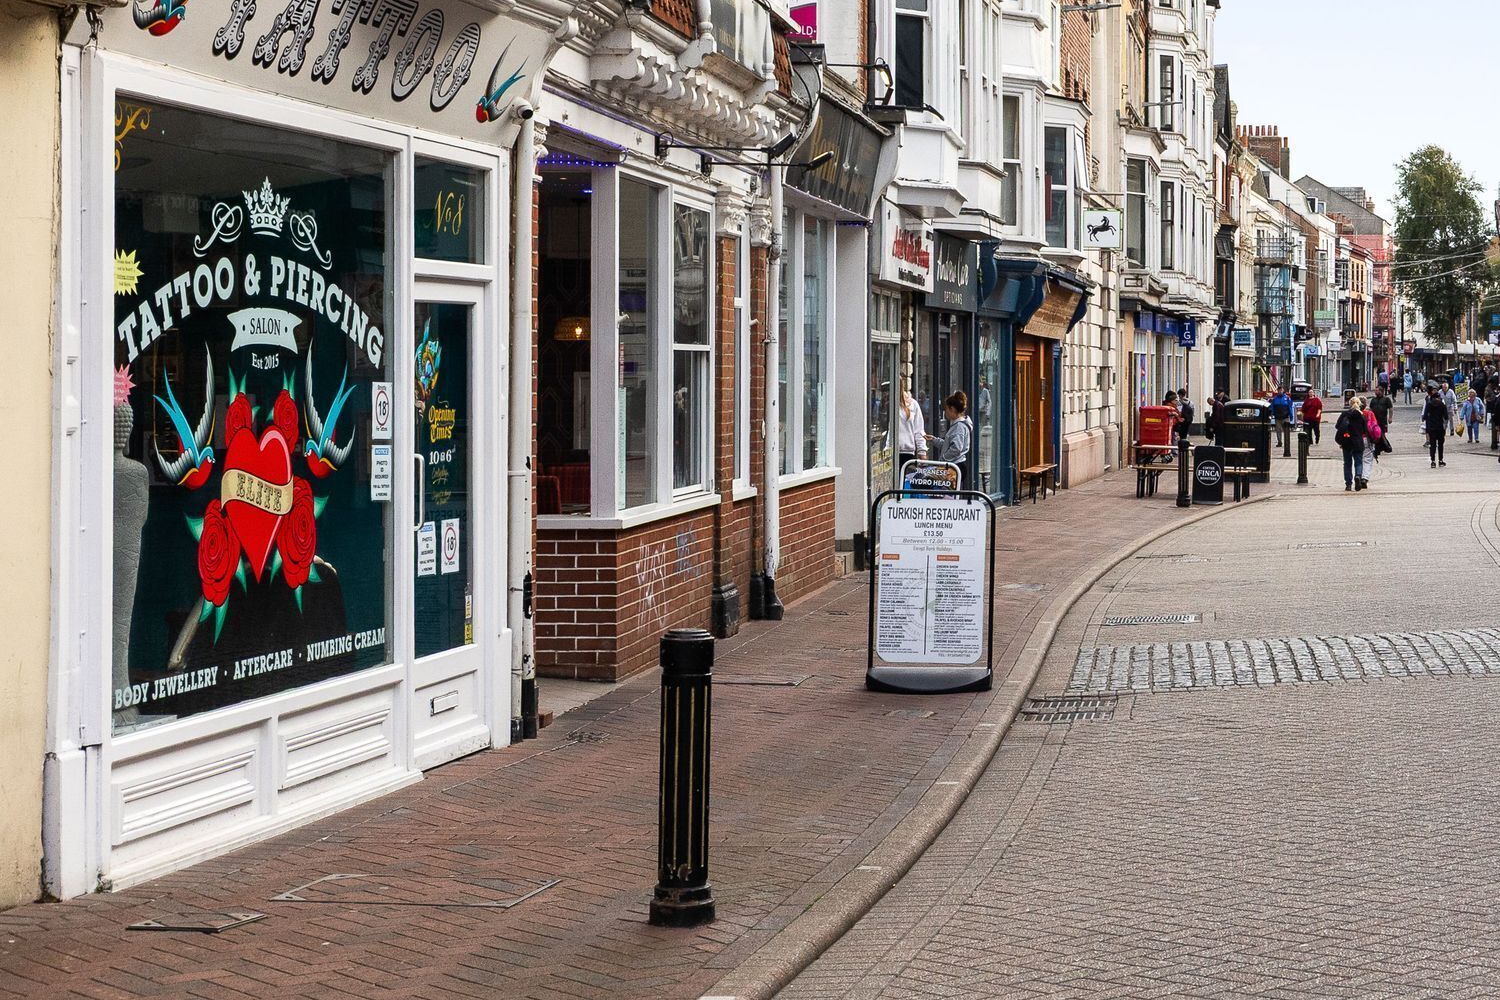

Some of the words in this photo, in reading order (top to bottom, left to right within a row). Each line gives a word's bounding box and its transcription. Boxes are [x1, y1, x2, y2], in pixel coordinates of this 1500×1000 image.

[944, 290, 963, 305] OPTICIANS
[118, 256, 235, 363] TATTOO
[244, 253, 261, 296] &
[270, 255, 384, 370] PIERCING
[250, 317, 281, 336] SALON
[251, 352, 264, 368] Est
[264, 353, 280, 370] 2015
[429, 405, 456, 423] Opening
[429, 450, 440, 465] 10
[446, 449, 452, 463] 6
[915, 468, 947, 476] JAPANESE
[1197, 469, 1220, 477] FINCA
[909, 478, 932, 486] HYDRO
[932, 479, 952, 487] HEAD
[236, 472, 283, 512] ELITE
[888, 506, 924, 520] TURKISH
[925, 508, 981, 522] RESTAURANT
[114, 682, 149, 709] BODY
[152, 666, 219, 701] JEWELLERY
[233, 648, 293, 681] AFTERCARE
[306, 635, 353, 663] NUMBING
[354, 627, 386, 650] CREAM
